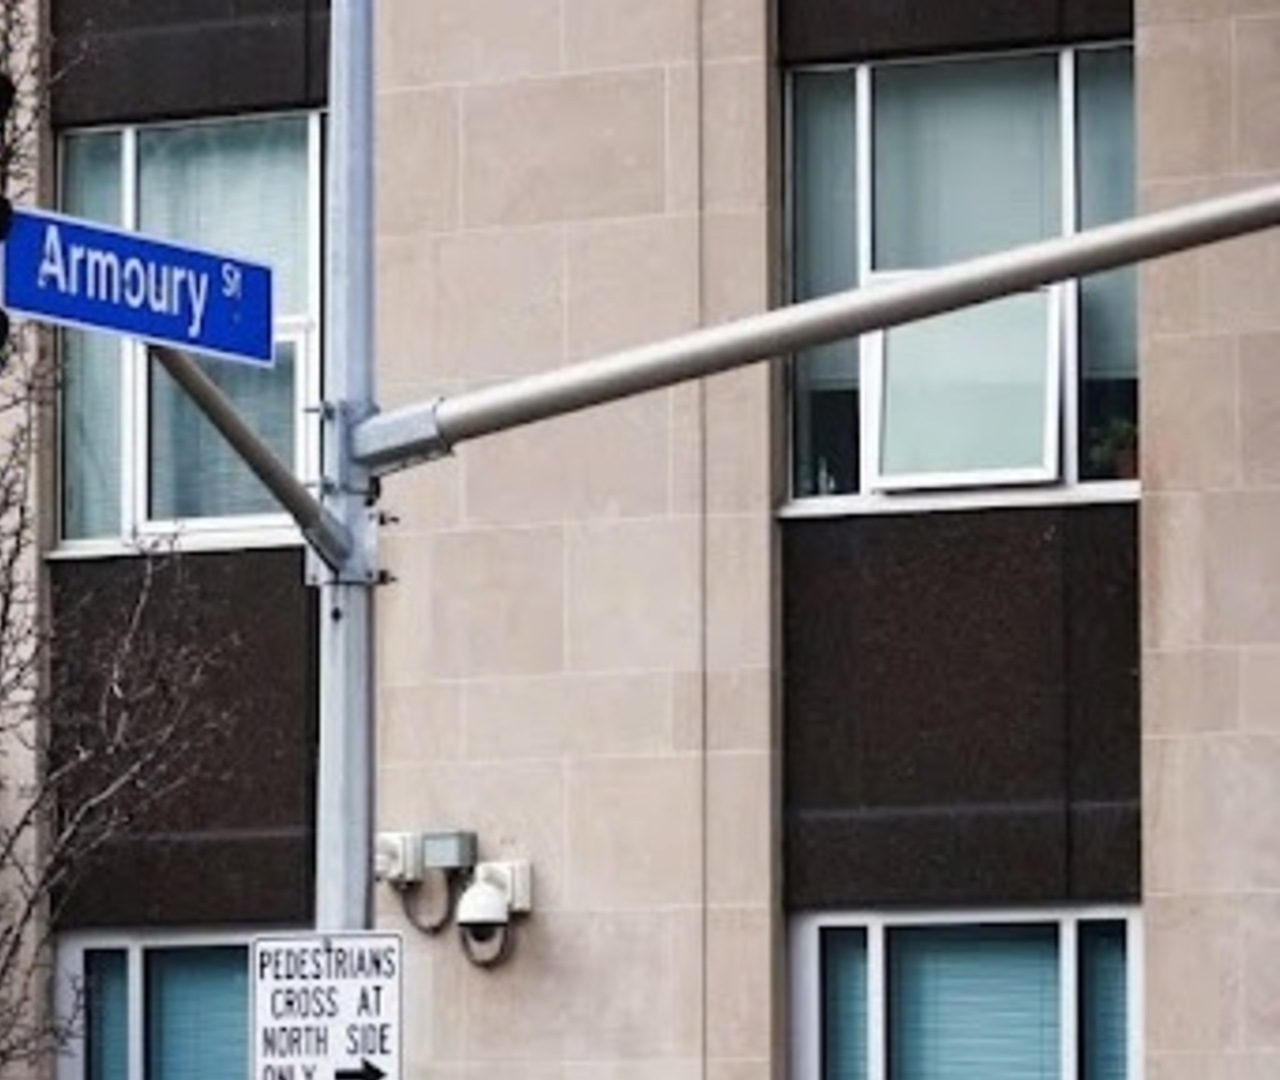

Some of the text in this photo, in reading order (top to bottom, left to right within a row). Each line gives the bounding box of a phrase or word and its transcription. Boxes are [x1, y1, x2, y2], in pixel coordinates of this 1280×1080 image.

[38, 225, 241, 337] Armoury St
[259, 947, 395, 980] PEDESTRIANS
[271, 986, 382, 1019] CROSS AT
[263, 1023, 392, 1057] NORTH SIDE
